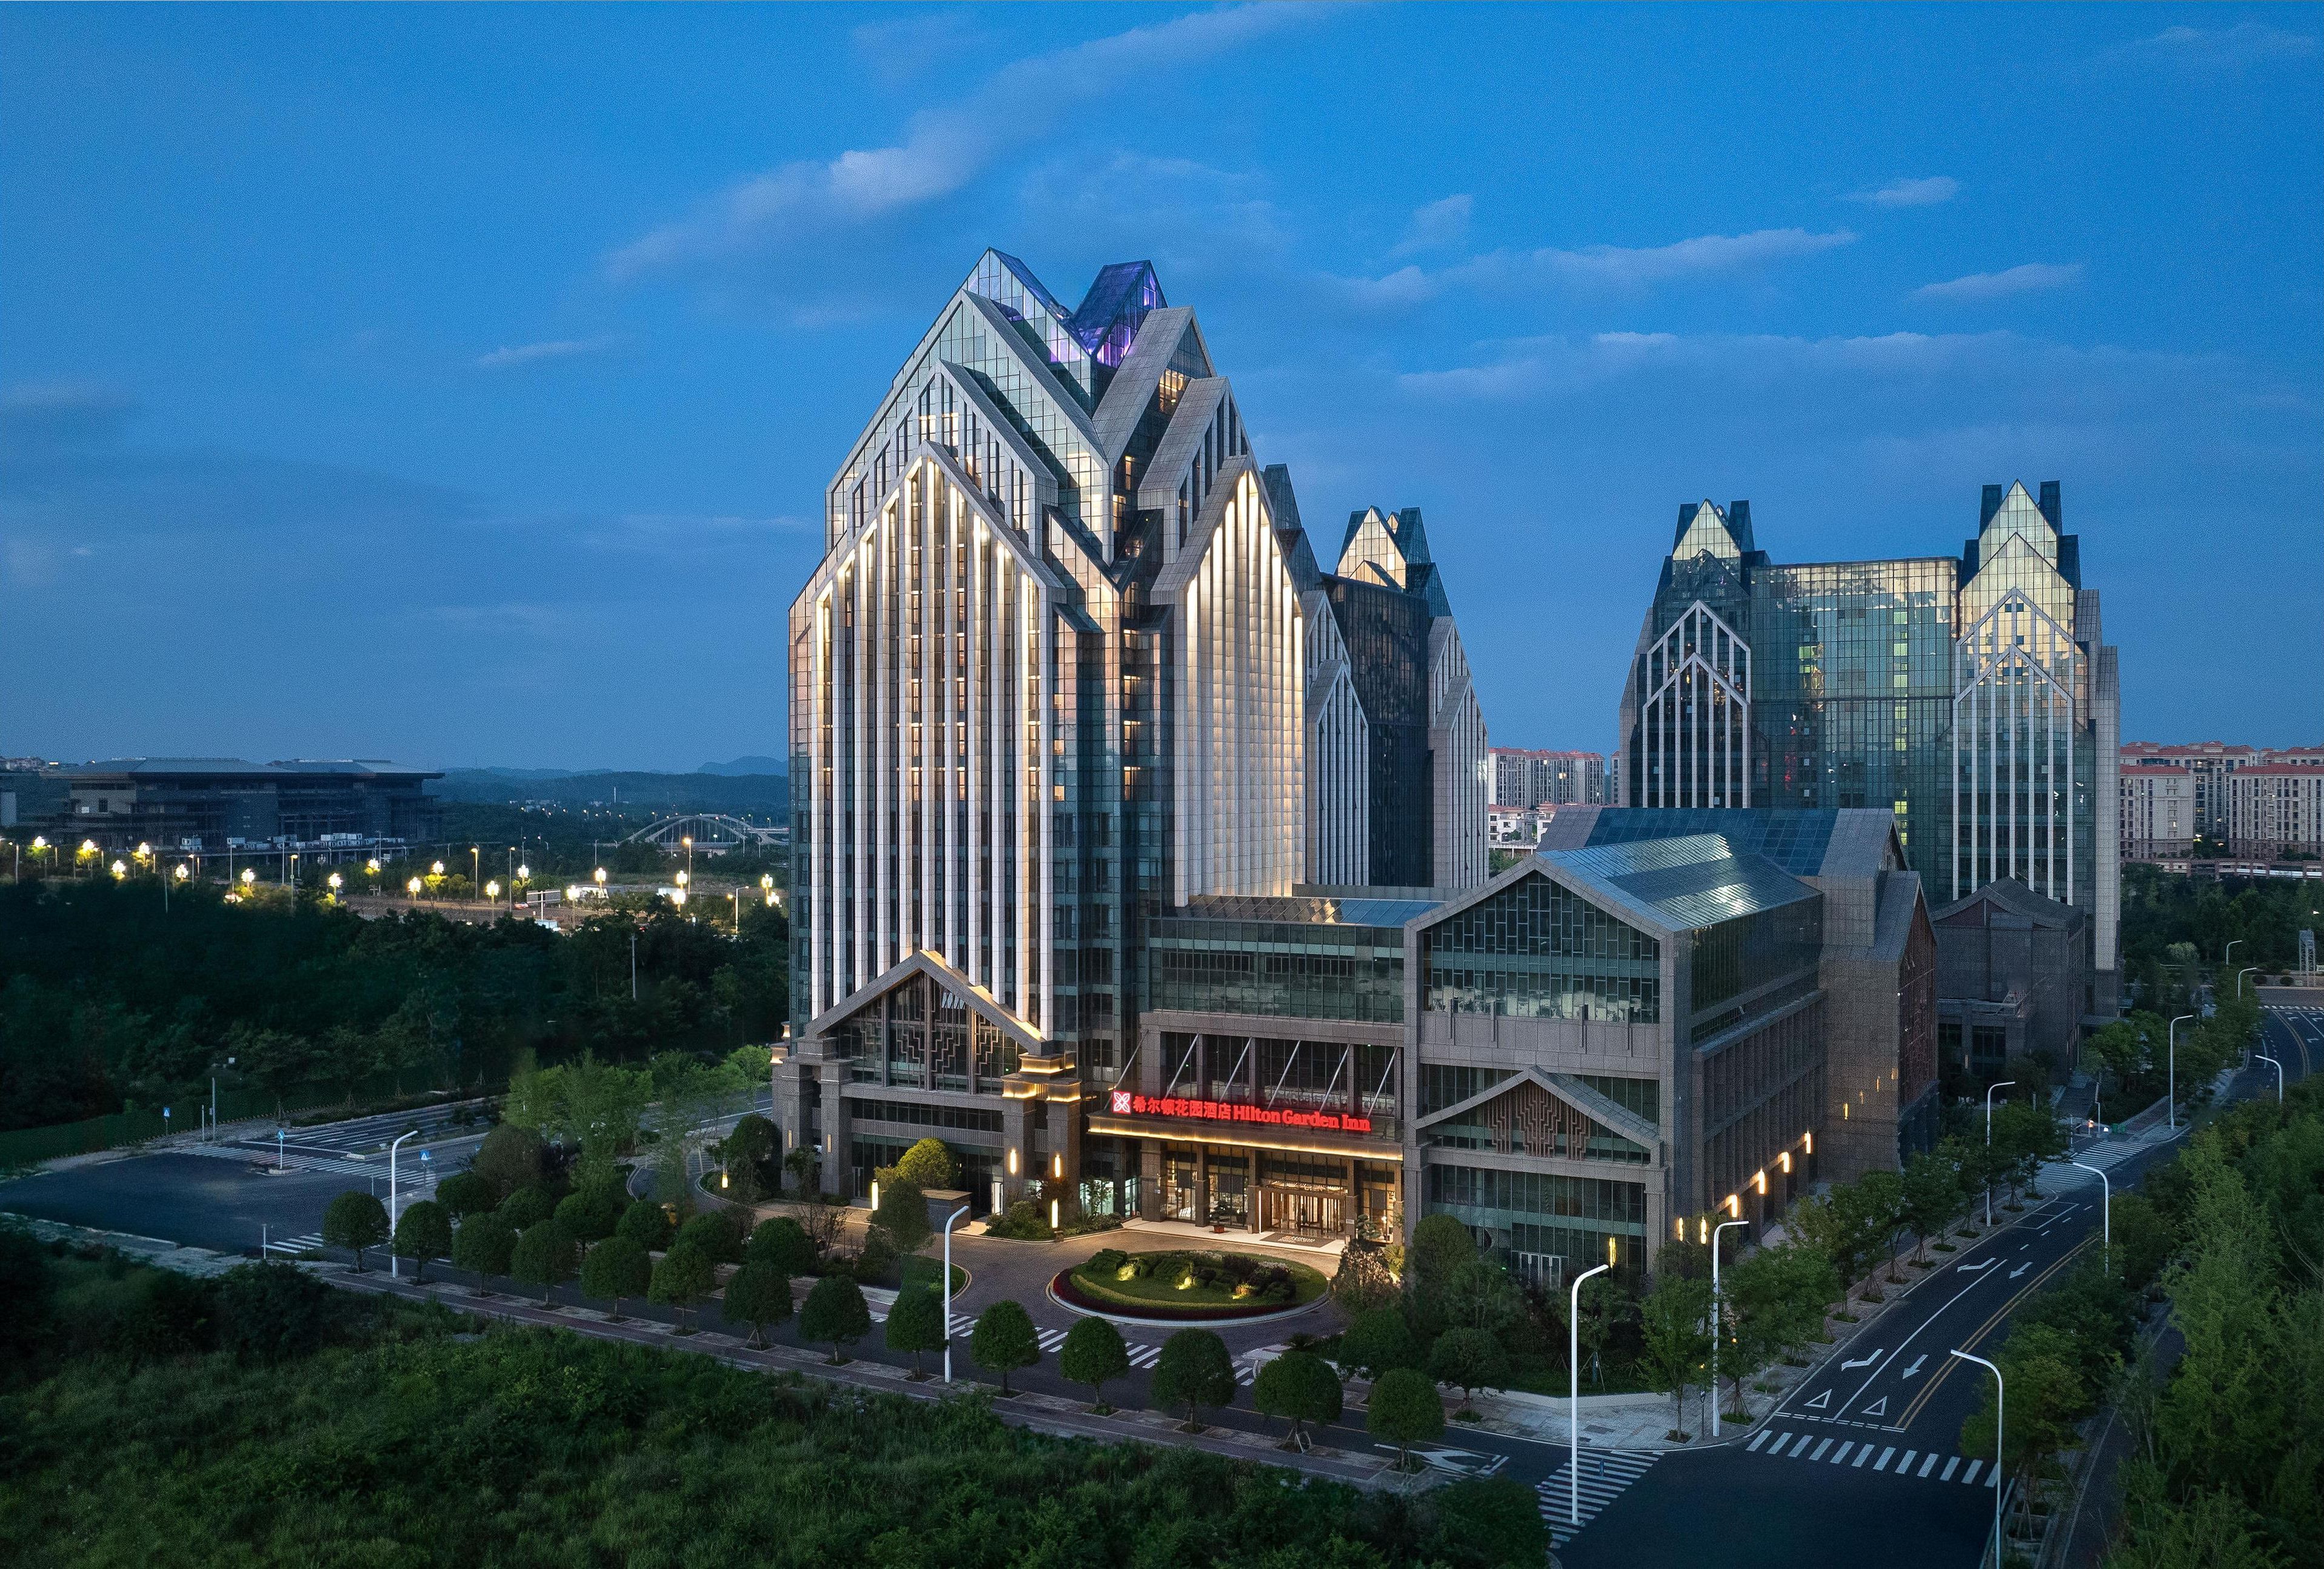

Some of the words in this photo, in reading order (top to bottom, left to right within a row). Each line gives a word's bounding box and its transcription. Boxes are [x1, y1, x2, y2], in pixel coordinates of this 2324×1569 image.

[1133, 1096, 1231, 1120] 希尔顿花园酒店
[1233, 1105, 1281, 1123] Hilton
[1282, 1109, 1340, 1128] Garden
[1341, 1114, 1371, 1131] Inn
